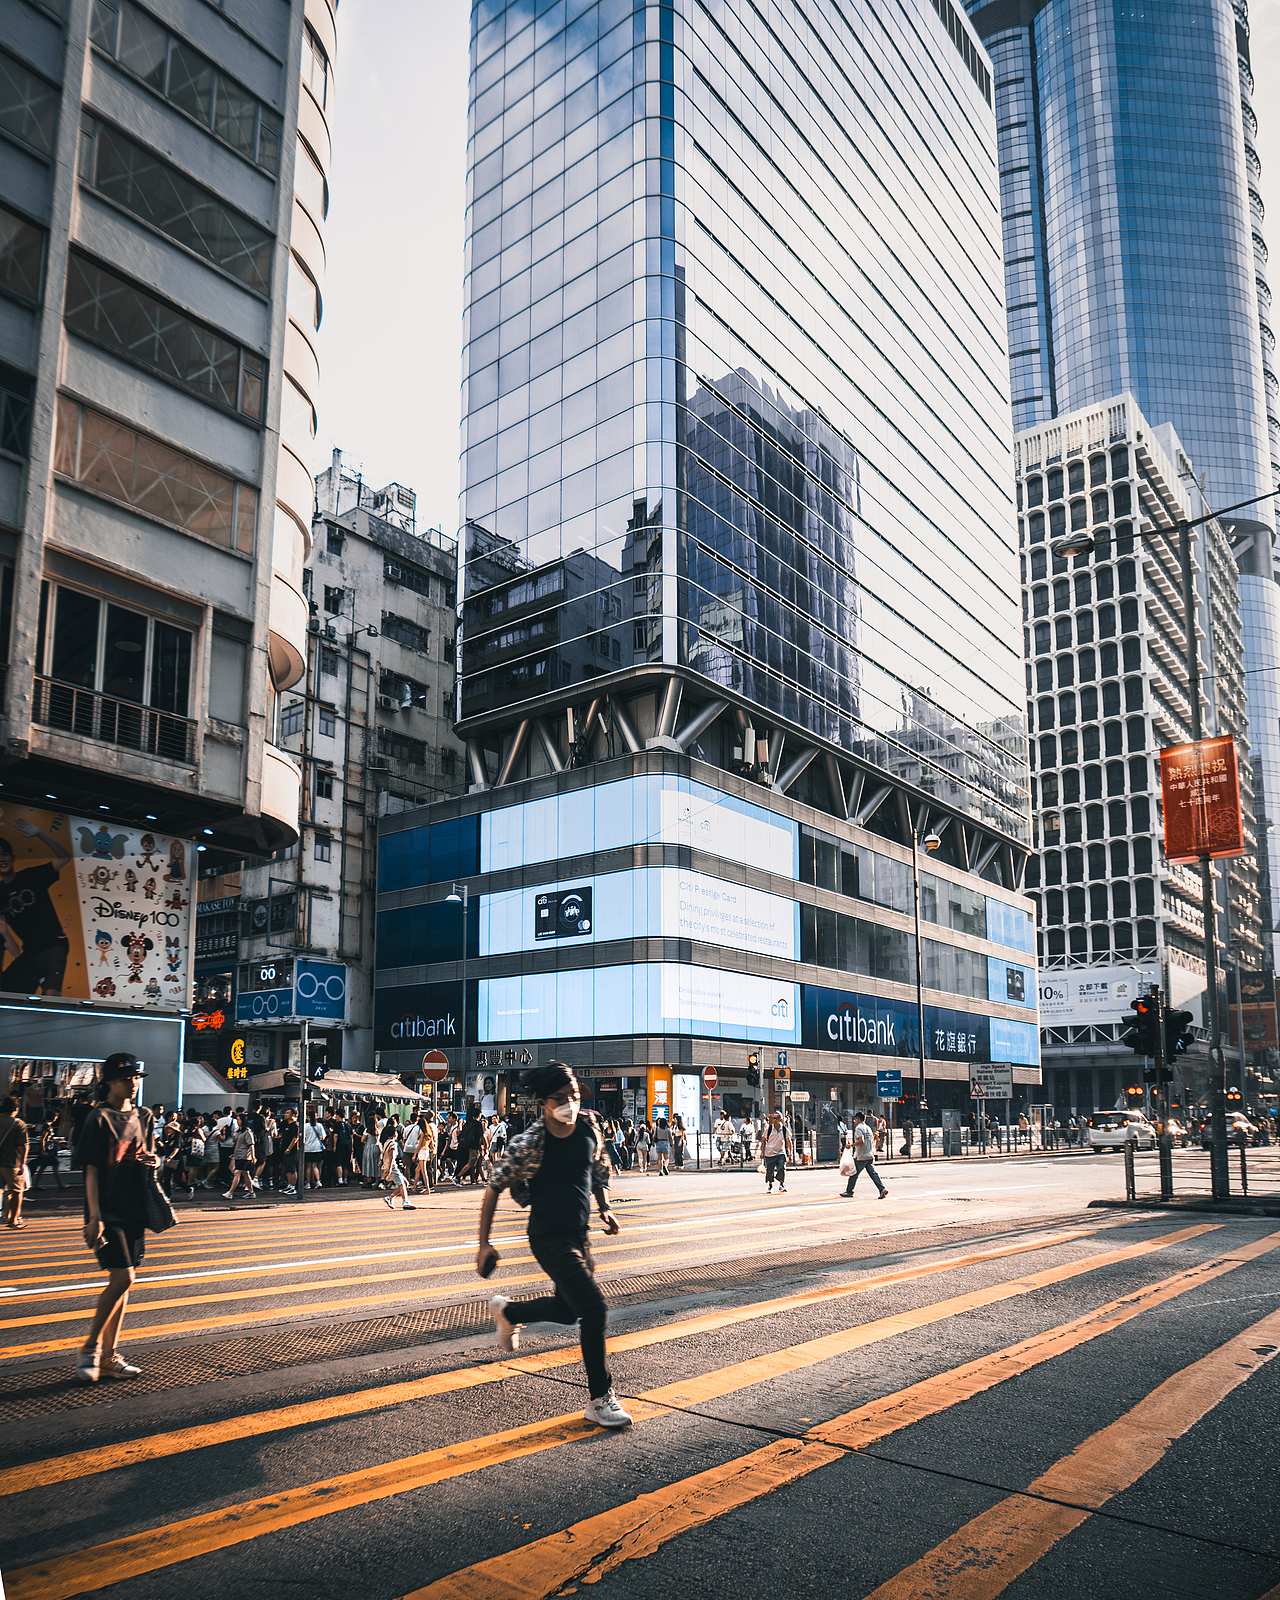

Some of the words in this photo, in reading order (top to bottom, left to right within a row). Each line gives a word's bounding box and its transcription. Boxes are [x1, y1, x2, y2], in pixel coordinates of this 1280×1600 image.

[1170, 774, 1228, 792] 中華人民共和國
[679, 882, 692, 891] Citi
[722, 893, 737, 904] Card
[90, 896, 148, 929] Disney
[150, 910, 180, 927] 100
[680, 901, 703, 916] Dining
[704, 908, 731, 922] privileges
[744, 917, 768, 930] selection
[680, 918, 692, 928] the
[694, 921, 710, 933] city's
[711, 925, 726, 935] most
[727, 928, 756, 942] celebrated
[758, 935, 788, 949] restaurants
[771, 999, 788, 1017] citi
[390, 1012, 456, 1038] citibank
[827, 1002, 895, 1045] citibank
[935, 1029, 976, 1054] 花旗銀行
